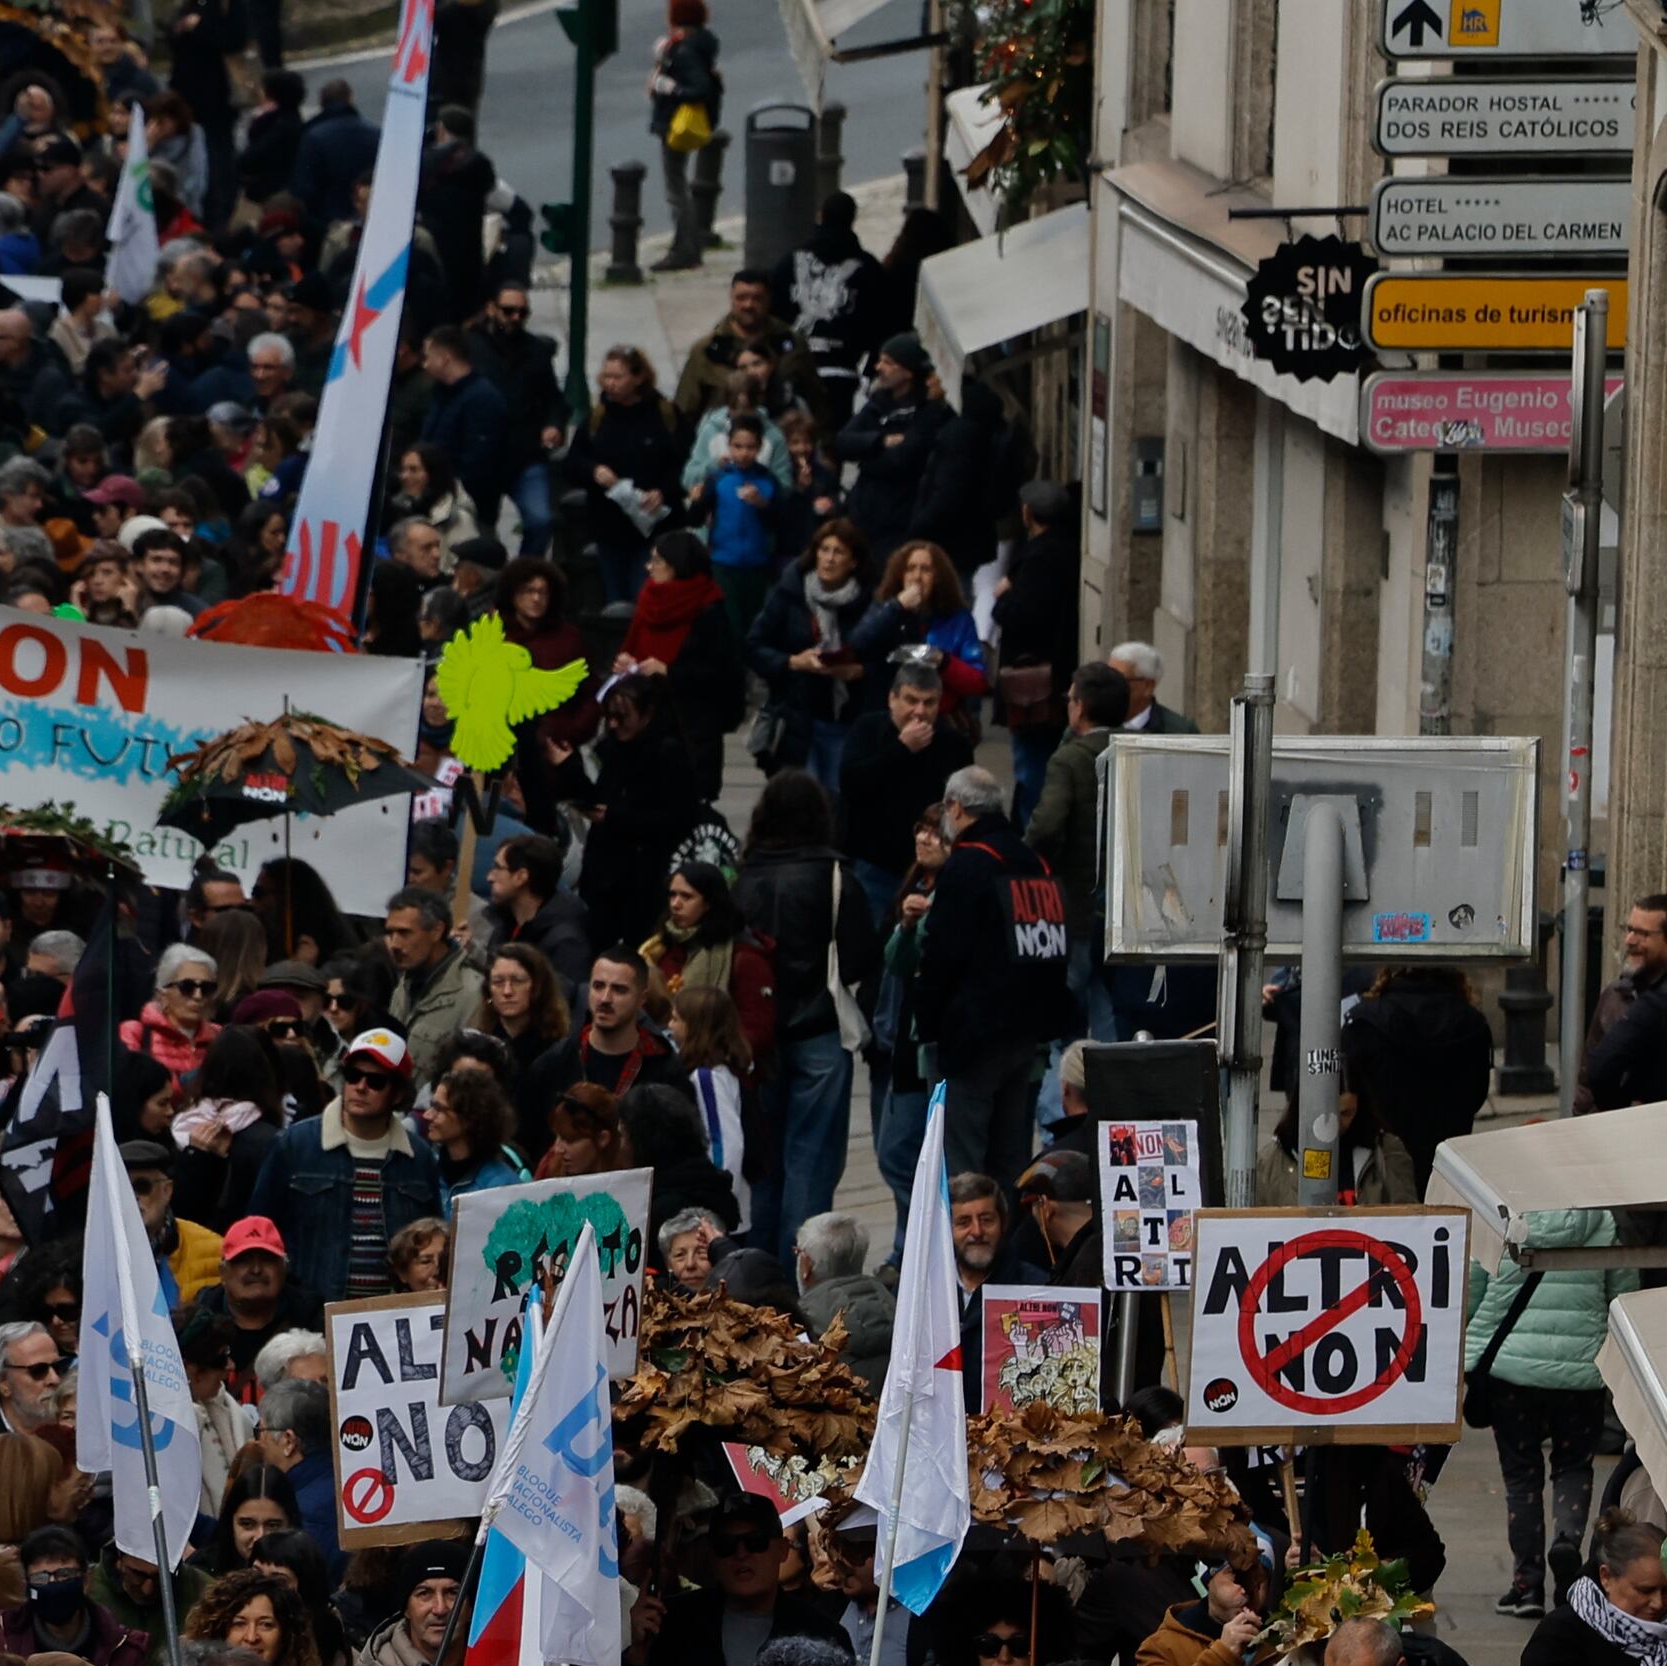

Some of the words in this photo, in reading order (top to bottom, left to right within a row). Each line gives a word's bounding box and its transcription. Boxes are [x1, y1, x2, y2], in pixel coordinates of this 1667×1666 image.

[1387, 96, 1479, 113] PARADOR
[1490, 96, 1562, 112] HOSTAL
[1387, 121, 1430, 138] DOS
[1441, 121, 1488, 138] REIS
[1499, 116, 1619, 138] CATÓLICOS
[1387, 199, 1448, 215] HOTEL
[1387, 224, 1411, 241] AC
[1418, 224, 1497, 241] PALACIO
[1503, 223, 1536, 241] DEL
[1544, 222, 1622, 241] CARMEN
[1297, 265, 1351, 299] SIN
[1378, 304, 1467, 324] oficinas
[1475, 304, 1502, 324] de
[1510, 304, 1575, 324] turism
[1376, 394, 1449, 410] museo
[1457, 388, 1558, 414] Eugenio
[52, 723, 173, 778] FUT
[108, 819, 250, 871] Natual
[1010, 879, 1065, 922] ALTRI
[1014, 919, 1067, 958] NON
[1137, 1133, 1163, 1158] NON
[1267, 1322, 1430, 1396] NON
[1208, 1391, 1237, 1411] NON
[342, 1433, 369, 1447] NON
[515, 1463, 562, 1506] BLOQUE
